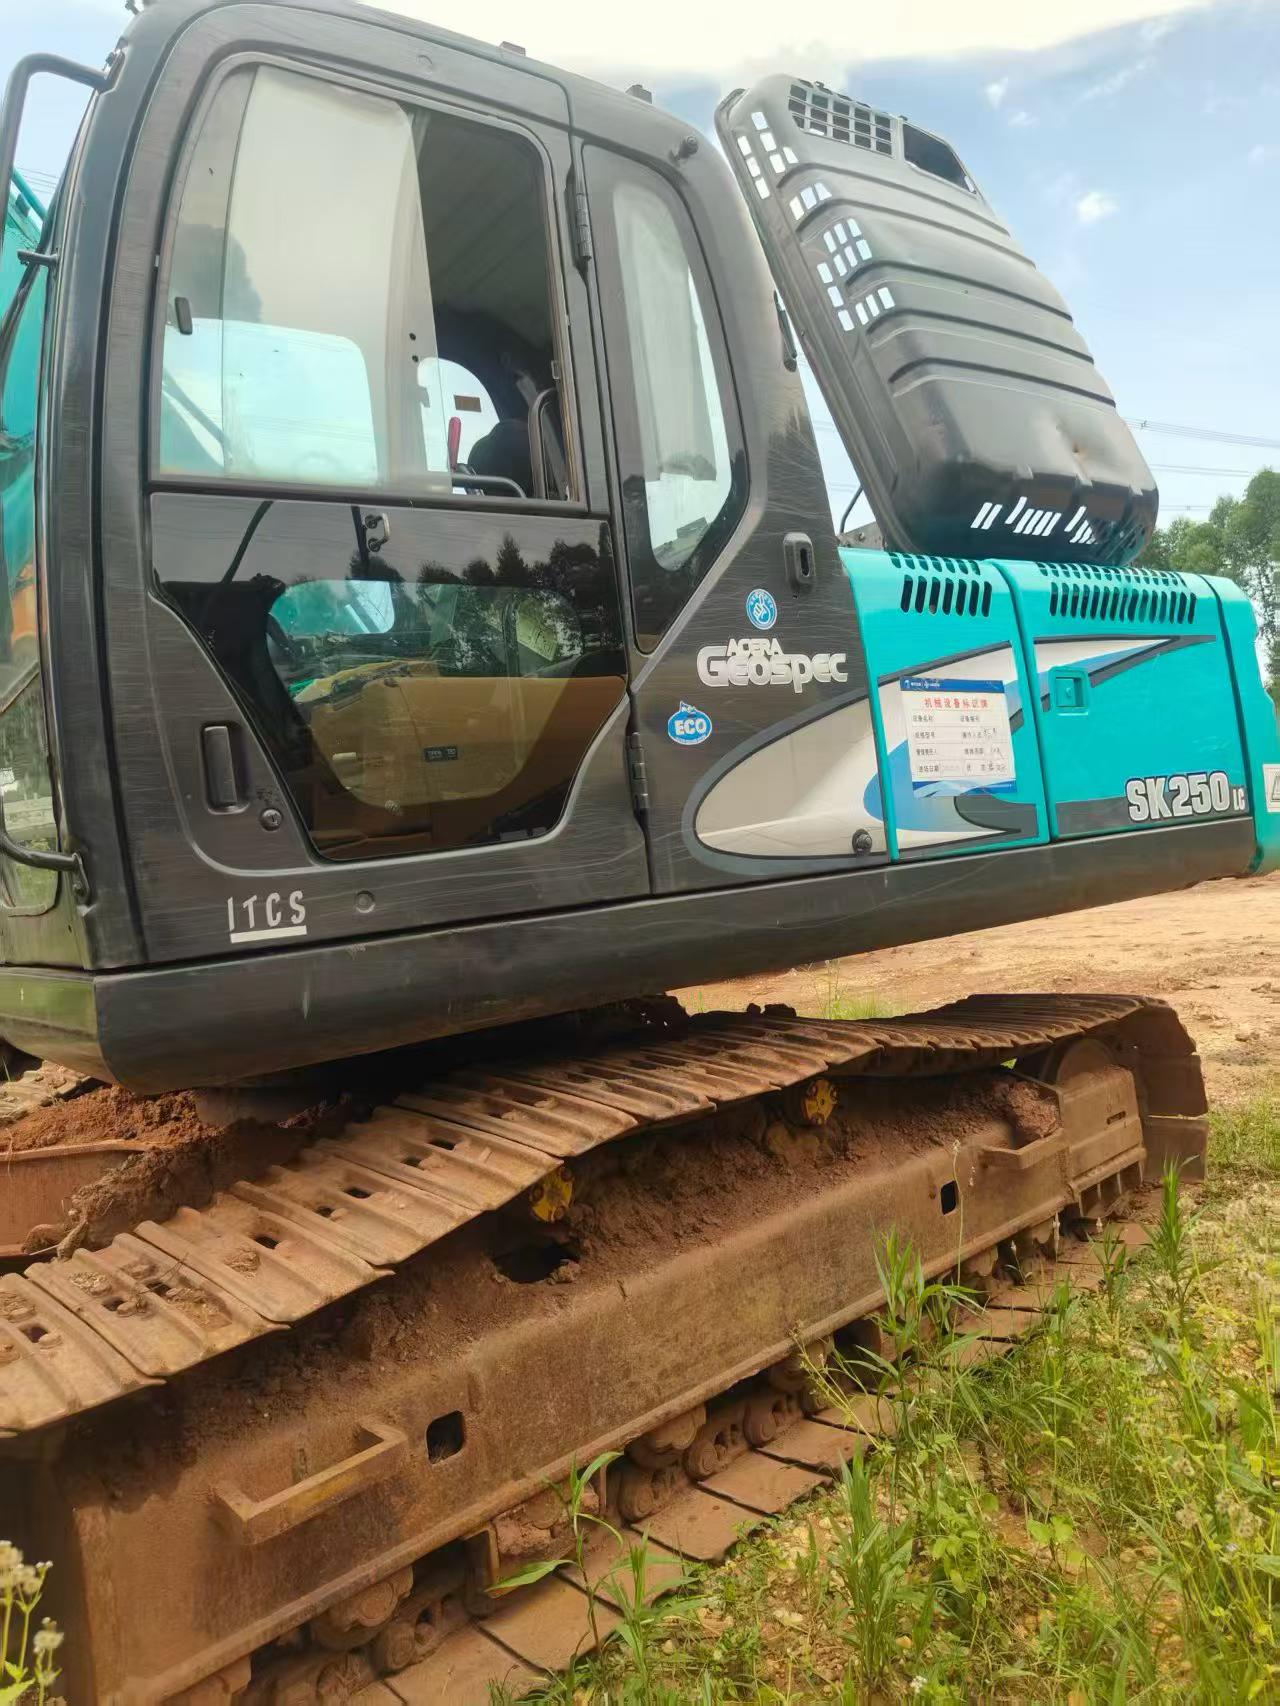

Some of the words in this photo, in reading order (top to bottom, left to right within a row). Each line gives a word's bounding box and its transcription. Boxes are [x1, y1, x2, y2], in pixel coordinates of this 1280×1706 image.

[727, 638, 784, 656] ACERA
[674, 718, 707, 736] ECO
[1126, 771, 1230, 822] SK250
[1232, 787, 1246, 811] LC
[227, 890, 306, 931] ITCS
